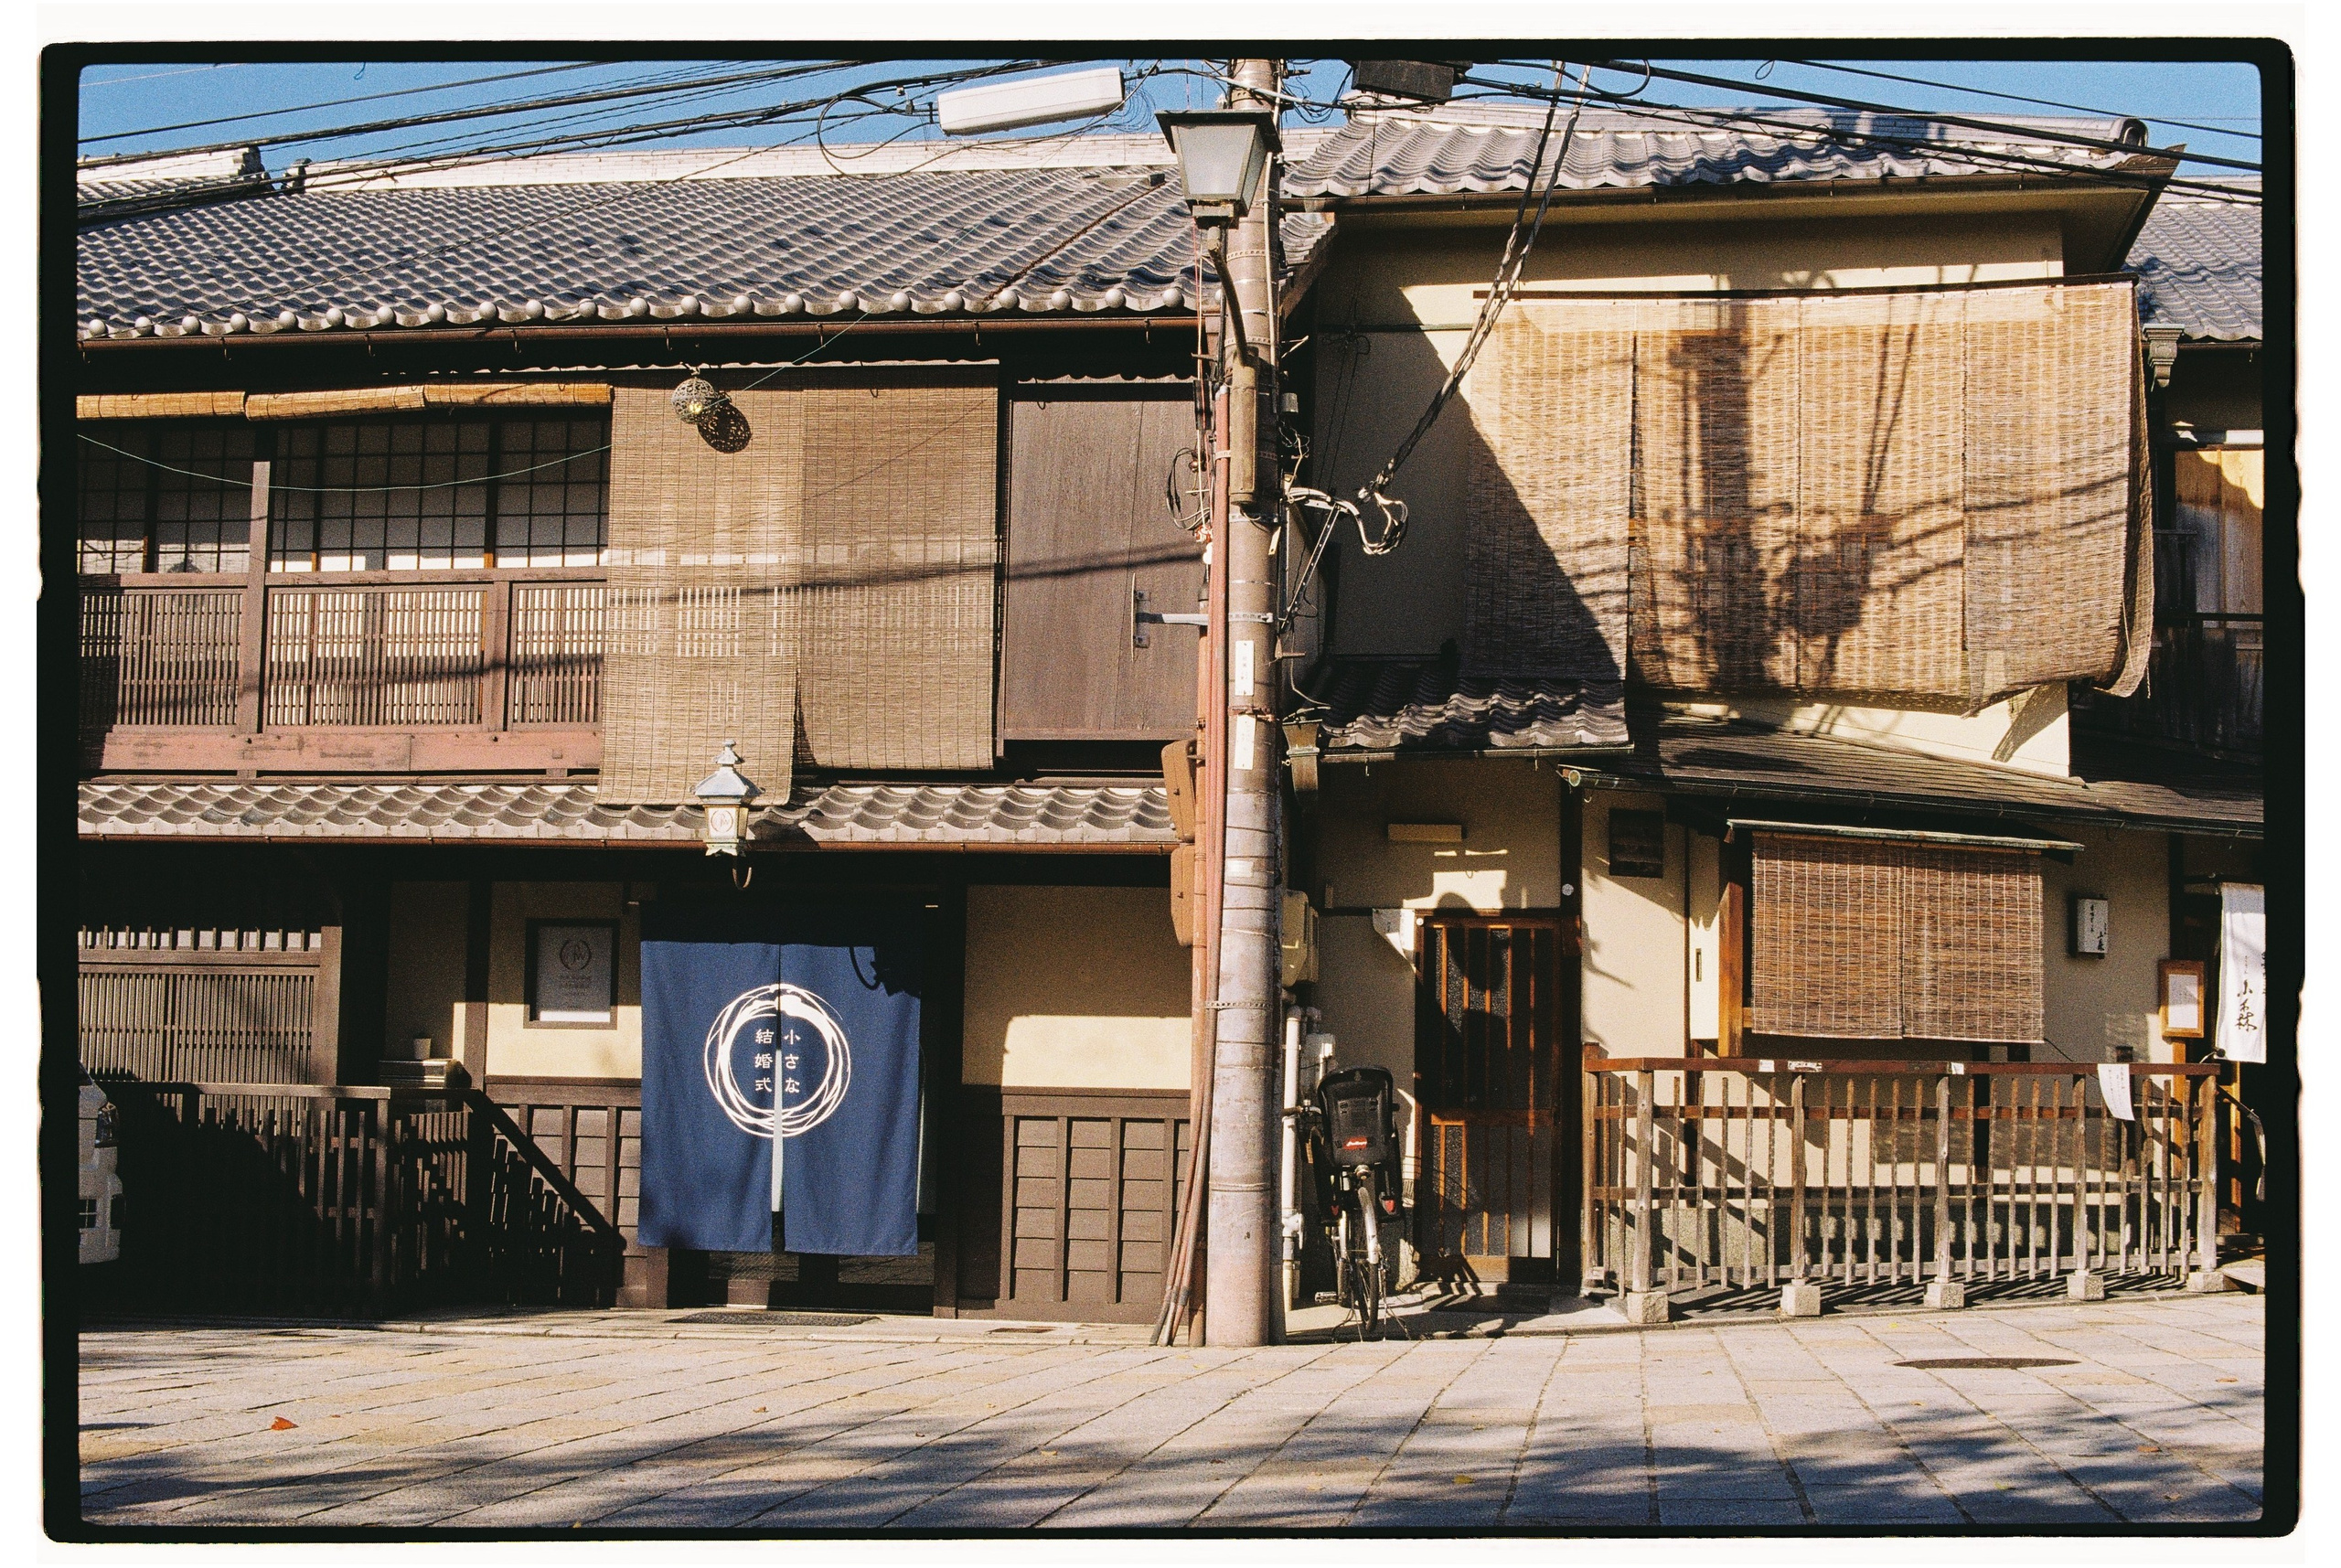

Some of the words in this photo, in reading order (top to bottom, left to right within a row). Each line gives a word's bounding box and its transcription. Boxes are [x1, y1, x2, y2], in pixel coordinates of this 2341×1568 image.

[754, 1028, 775, 1093] 結婚式
[783, 1029, 801, 1093] 小さな
